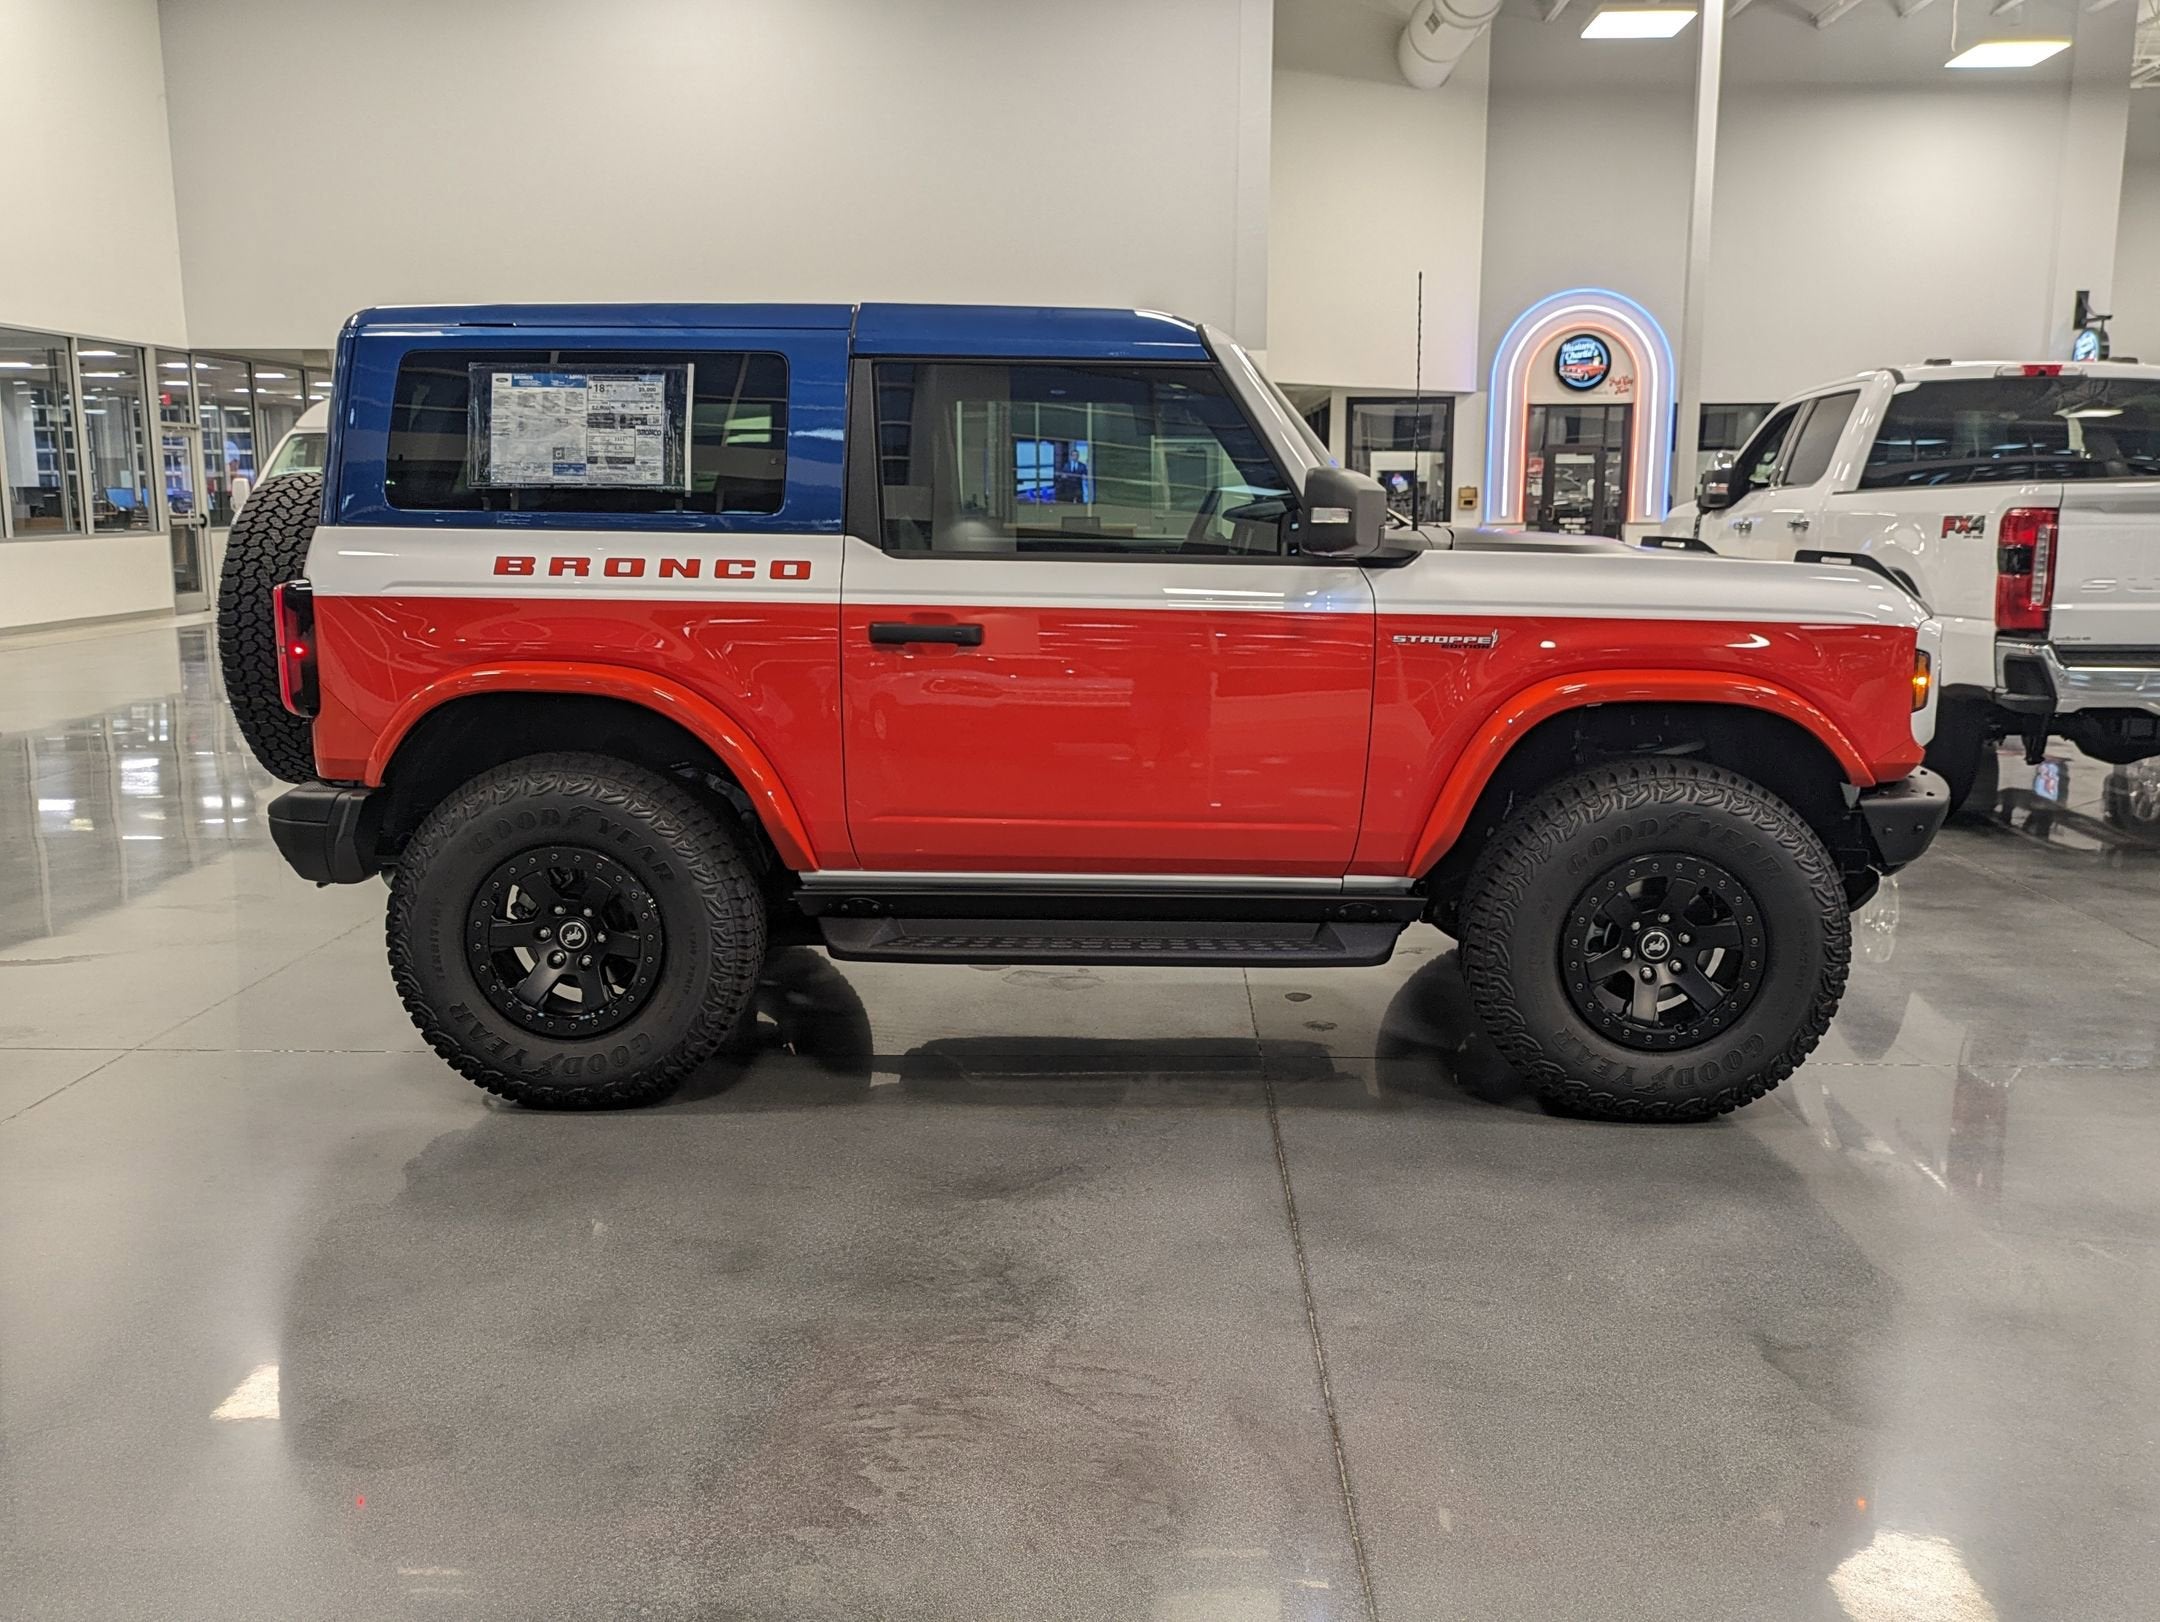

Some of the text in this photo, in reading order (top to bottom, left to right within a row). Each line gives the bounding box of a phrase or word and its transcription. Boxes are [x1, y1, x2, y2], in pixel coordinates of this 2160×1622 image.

[593, 383, 606, 393] 18
[1941, 515, 1986, 538] FX4
[493, 556, 812, 580] BRONCO
[1392, 634, 1492, 644] STROPPE
